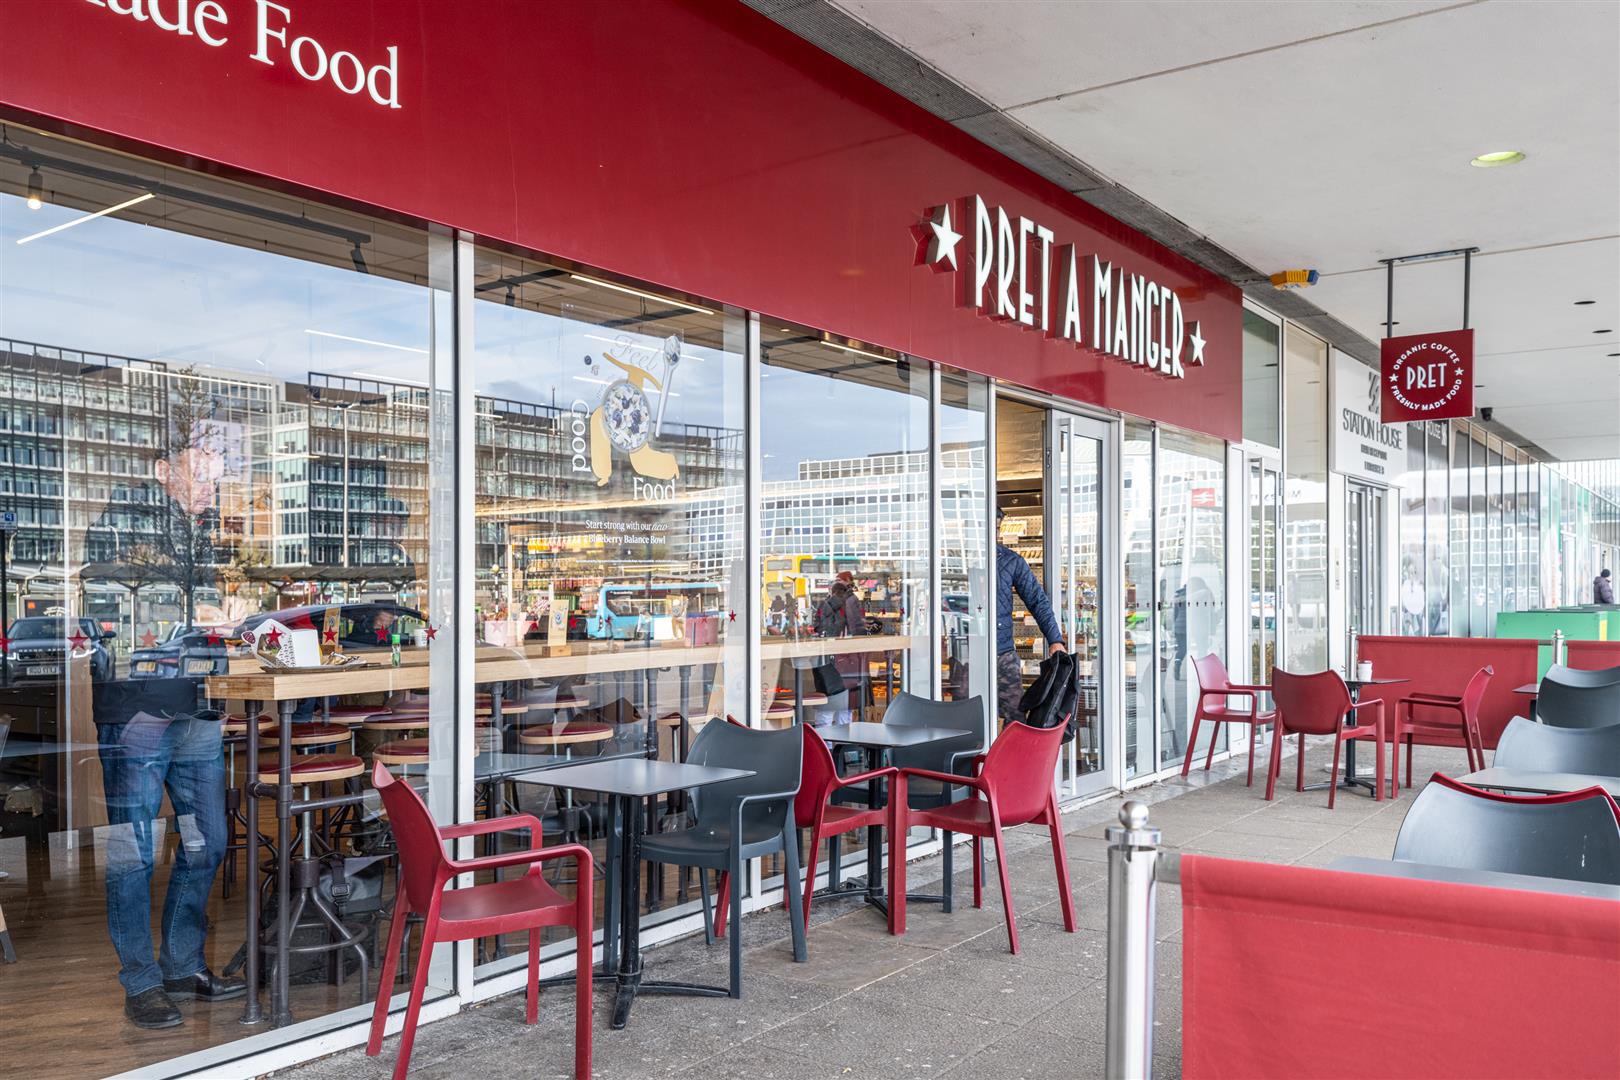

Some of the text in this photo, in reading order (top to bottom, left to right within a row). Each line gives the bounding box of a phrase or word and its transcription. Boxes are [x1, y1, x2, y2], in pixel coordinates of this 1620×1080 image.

[86, 0, 402, 109] ade Food
[976, 193, 1185, 379] PRET A MANGER
[1393, 342, 1460, 370] ORGANIC COFFEE
[1406, 363, 1447, 390] PRET
[1391, 385, 1420, 410] FRESHLY
[1421, 398, 1446, 411] MADE
[1446, 379, 1462, 400] FOOD
[571, 399, 591, 472] Good
[1343, 408, 1402, 450] STATION HOUSE
[633, 476, 675, 502] Food
[585, 520, 602, 529] Start
[603, 521, 625, 531] strong
[626, 521, 640, 530] with
[640, 523, 651, 531] our
[589, 534, 666, 545] Blueberry Balance Bowl
